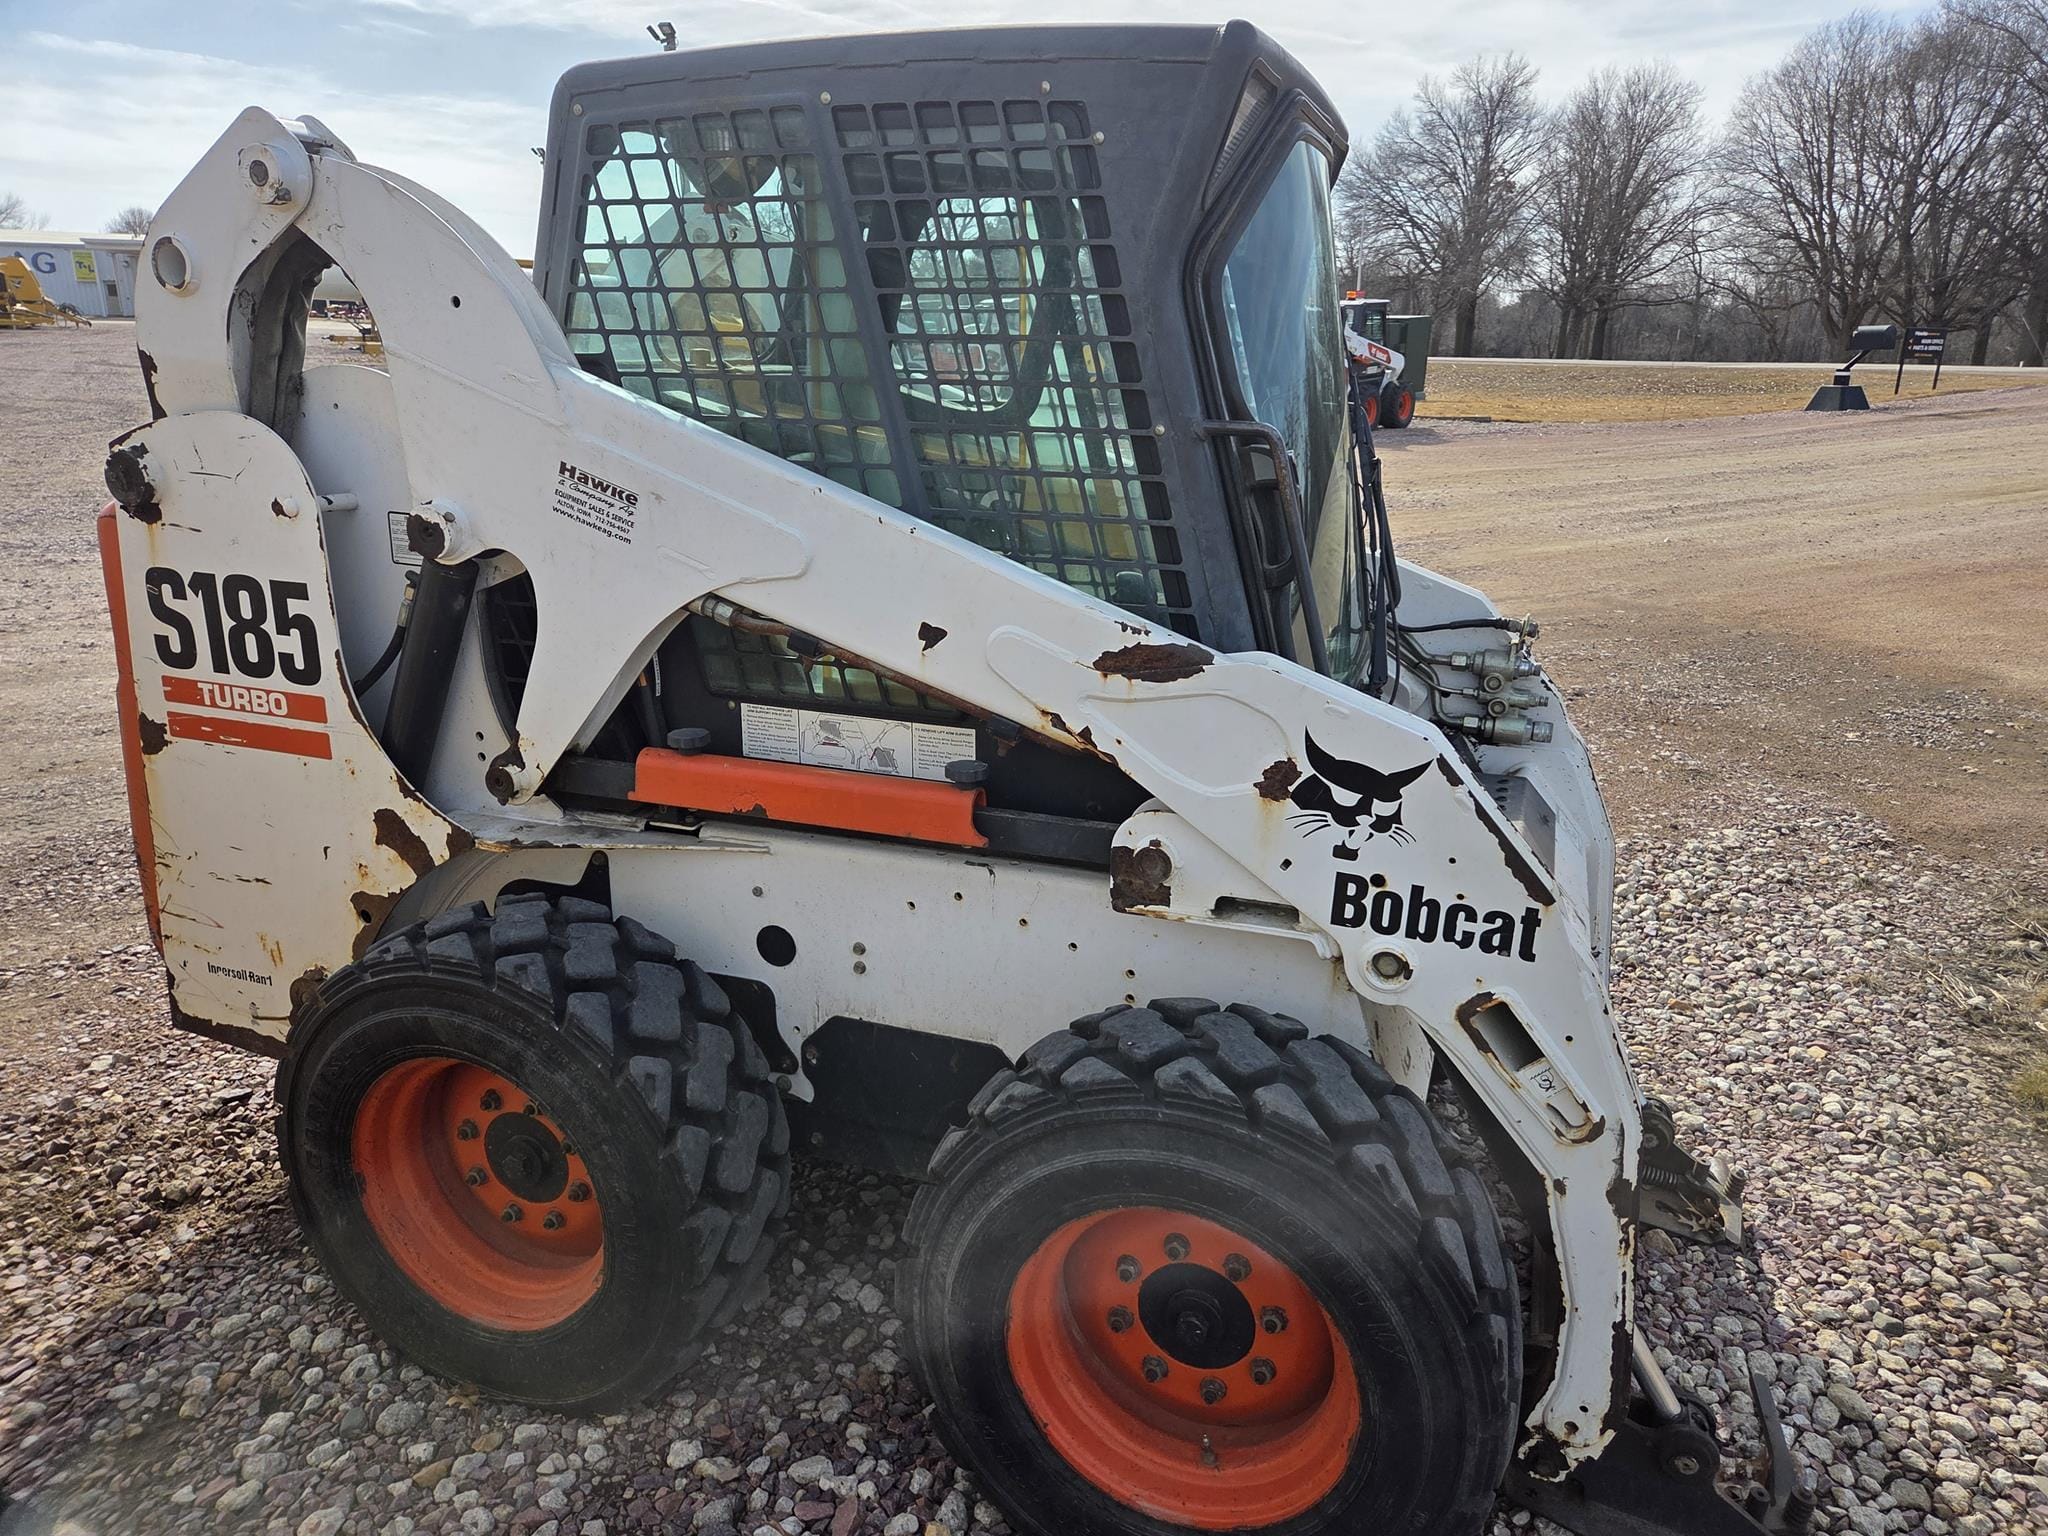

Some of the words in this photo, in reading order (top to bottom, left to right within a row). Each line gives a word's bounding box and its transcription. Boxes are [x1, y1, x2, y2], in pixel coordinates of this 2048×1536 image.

[558, 461, 639, 506] Hawke
[569, 482, 616, 508] Company
[618, 504, 635, 517] Ag
[552, 505, 632, 545] www.hawkeag.com
[555, 489, 588, 508] EQUIPMENT
[588, 502, 606, 516] SALES
[611, 513, 635, 529] SERVICE
[576, 507, 592, 518] IOWA
[145, 566, 322, 686] S185
[196, 681, 288, 716] TURBO
[1330, 871, 1541, 963] Bobcat
